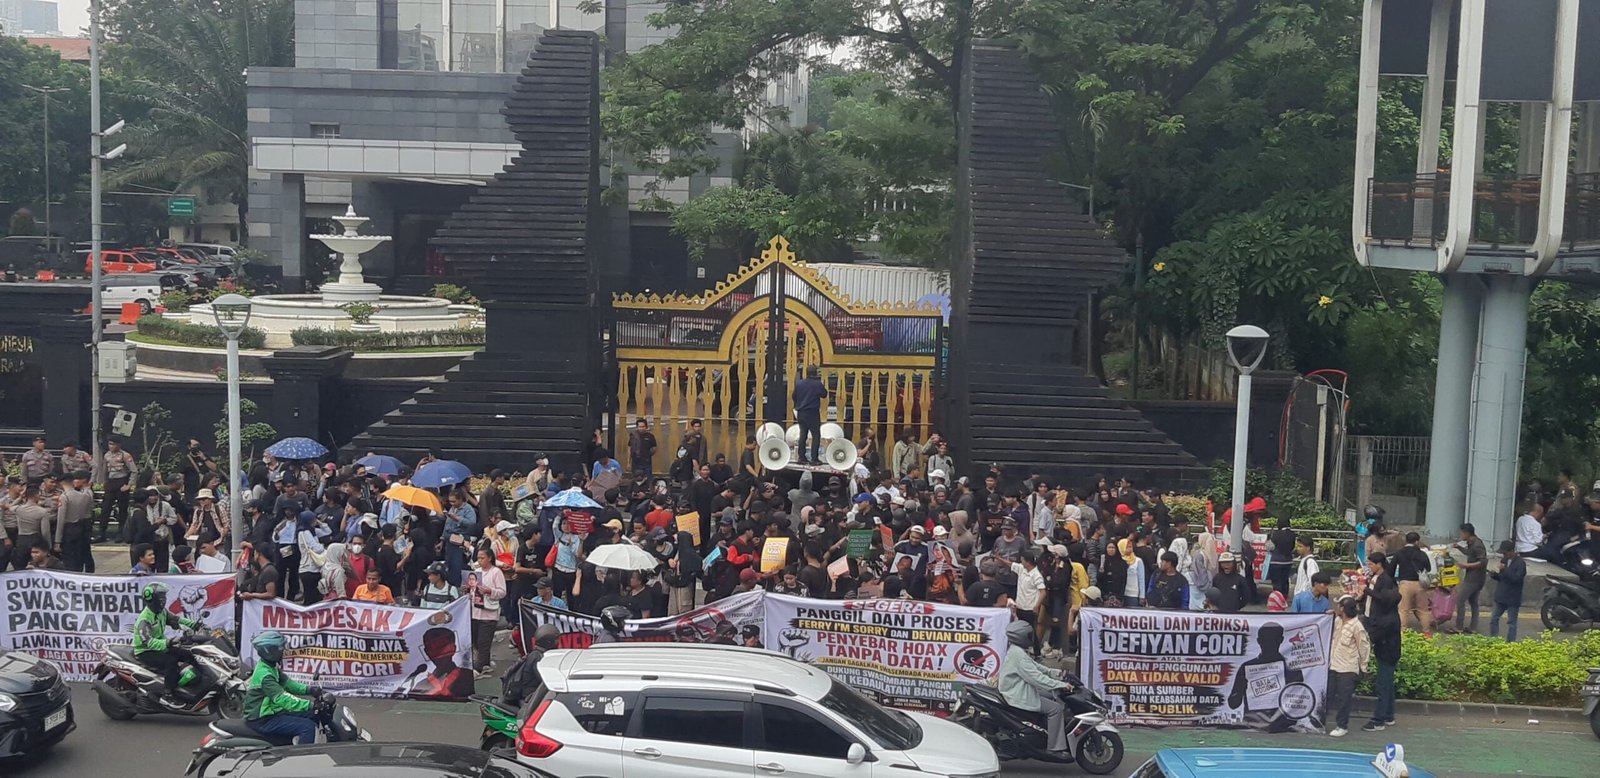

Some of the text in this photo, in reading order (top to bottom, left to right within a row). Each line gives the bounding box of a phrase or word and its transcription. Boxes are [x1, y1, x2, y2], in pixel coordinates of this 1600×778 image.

[6, 578, 139, 593] DUKUNG PENUH
[7, 590, 146, 613] SWASEMBAD
[850, 600, 926, 614] SEGERA
[8, 611, 120, 633] PANGAN
[263, 605, 393, 632] MENDESAK
[796, 607, 866, 624] PANGGIL
[872, 612, 905, 628] DAN
[1102, 614, 1250, 633] PANGGIL DAN PERIKSA
[798, 619, 981, 643] FERRY I'M SORRY DAN DEVIAN QORI
[12, 634, 60, 650] LAWAN
[327, 636, 366, 650] METRO
[371, 640, 404, 652] JAYA
[817, 631, 948, 657] PENYEBAR HOAX
[1104, 630, 1242, 655] DEFIYAN CORI
[1290, 641, 1315, 652] JANGAN
[43, 651, 66, 661] JAGA
[299, 649, 342, 659] MEMANGGIL
[345, 650, 359, 659] DAN
[360, 652, 404, 661] MEMERIKSA
[826, 644, 882, 663] TANPA
[276, 658, 395, 677] EFIYAN CORI
[822, 657, 847, 665] JANGAN
[848, 659, 879, 670] GAGALKAN
[879, 665, 921, 676] SWASEMBADA
[962, 663, 988, 679] HOAX
[1107, 660, 1222, 673] DUGAAN PENGGUNAAN
[827, 665, 952, 690] DUKUNG SWASEMBADA PANGAN
[1107, 671, 1220, 684] DATA TIDAK VALID
[1256, 677, 1271, 687] DATA
[849, 676, 910, 696] KEDAULATAN
[1108, 685, 1194, 695] SERTA BUKA SUMBER
[1129, 694, 1220, 704] DAN KEABSAHAN DATA
[1129, 703, 1199, 714] KE PUBLIK.
